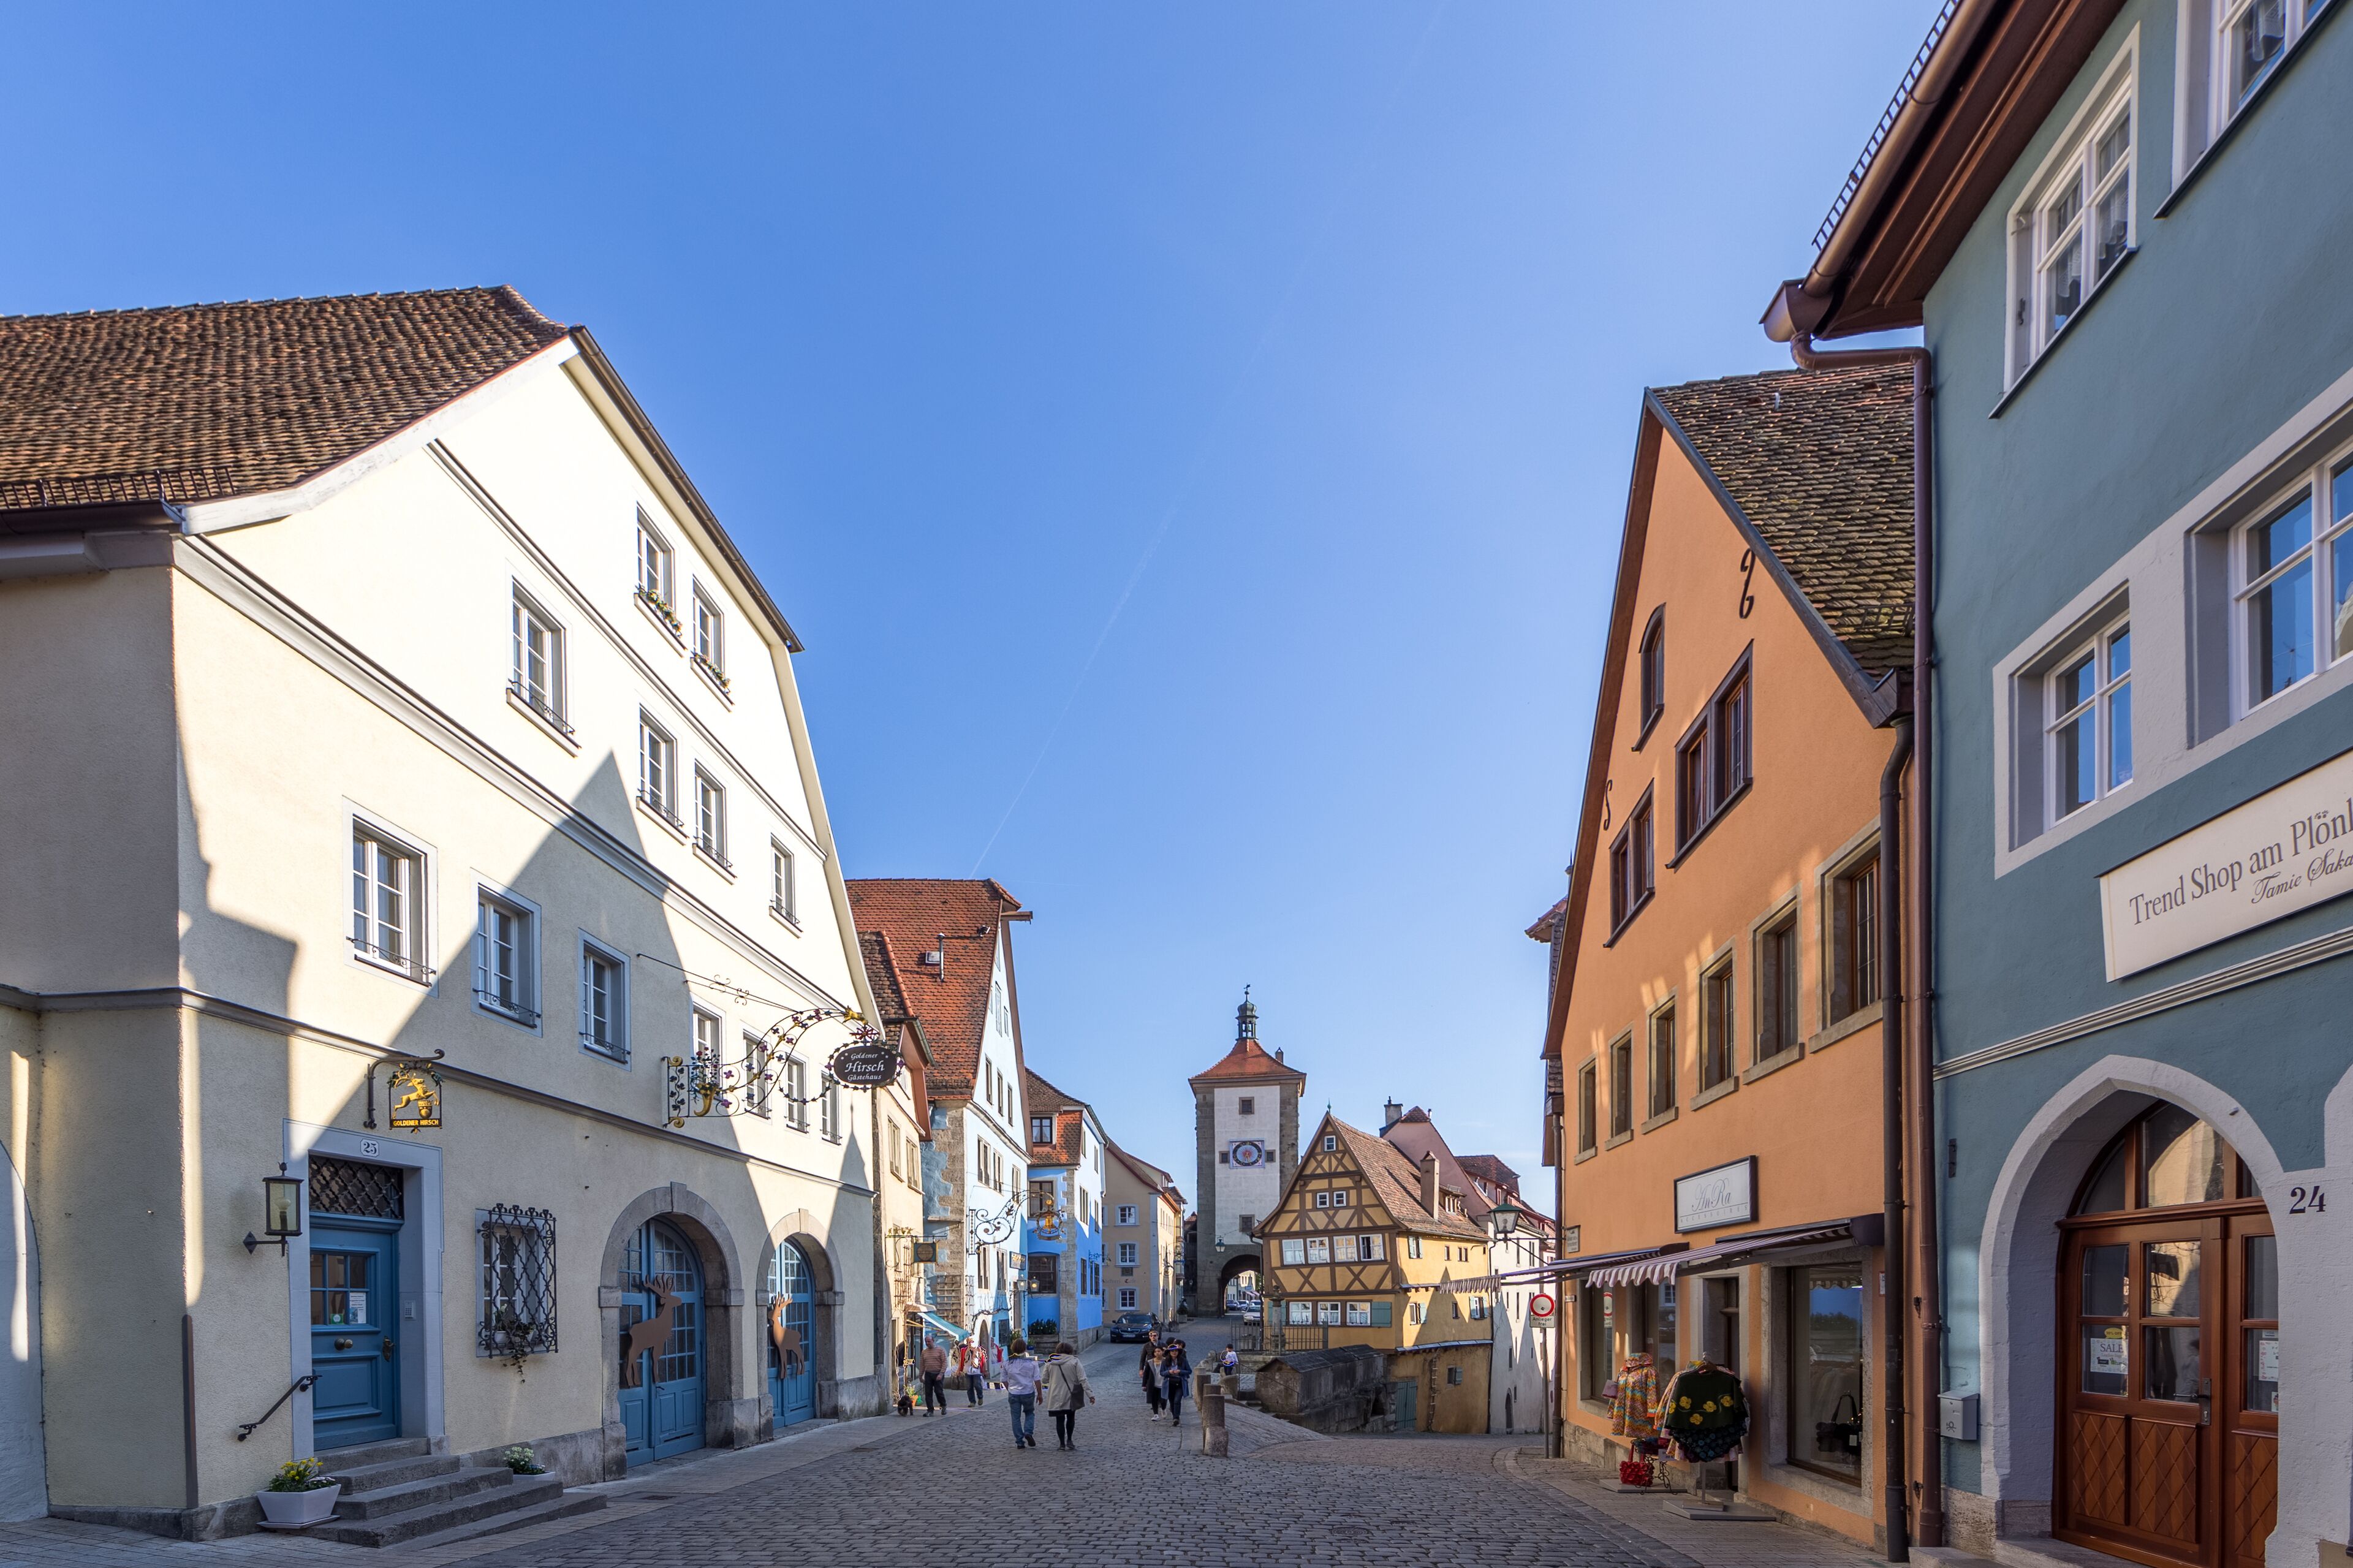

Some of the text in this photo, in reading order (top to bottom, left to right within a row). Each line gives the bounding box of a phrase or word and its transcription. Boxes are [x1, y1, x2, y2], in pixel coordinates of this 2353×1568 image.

[2129, 874, 2186, 925] Trend
[2191, 859, 2243, 901] Shop
[2249, 841, 2284, 875] am
[2251, 871, 2302, 904] Tamie
[844, 1060, 884, 1072] Hirsch
[847, 1073, 882, 1082] Gästehaus
[363, 1141, 377, 1154] 25
[2289, 1185, 2327, 1214] 24
[2100, 1343, 2123, 1353] SALE
